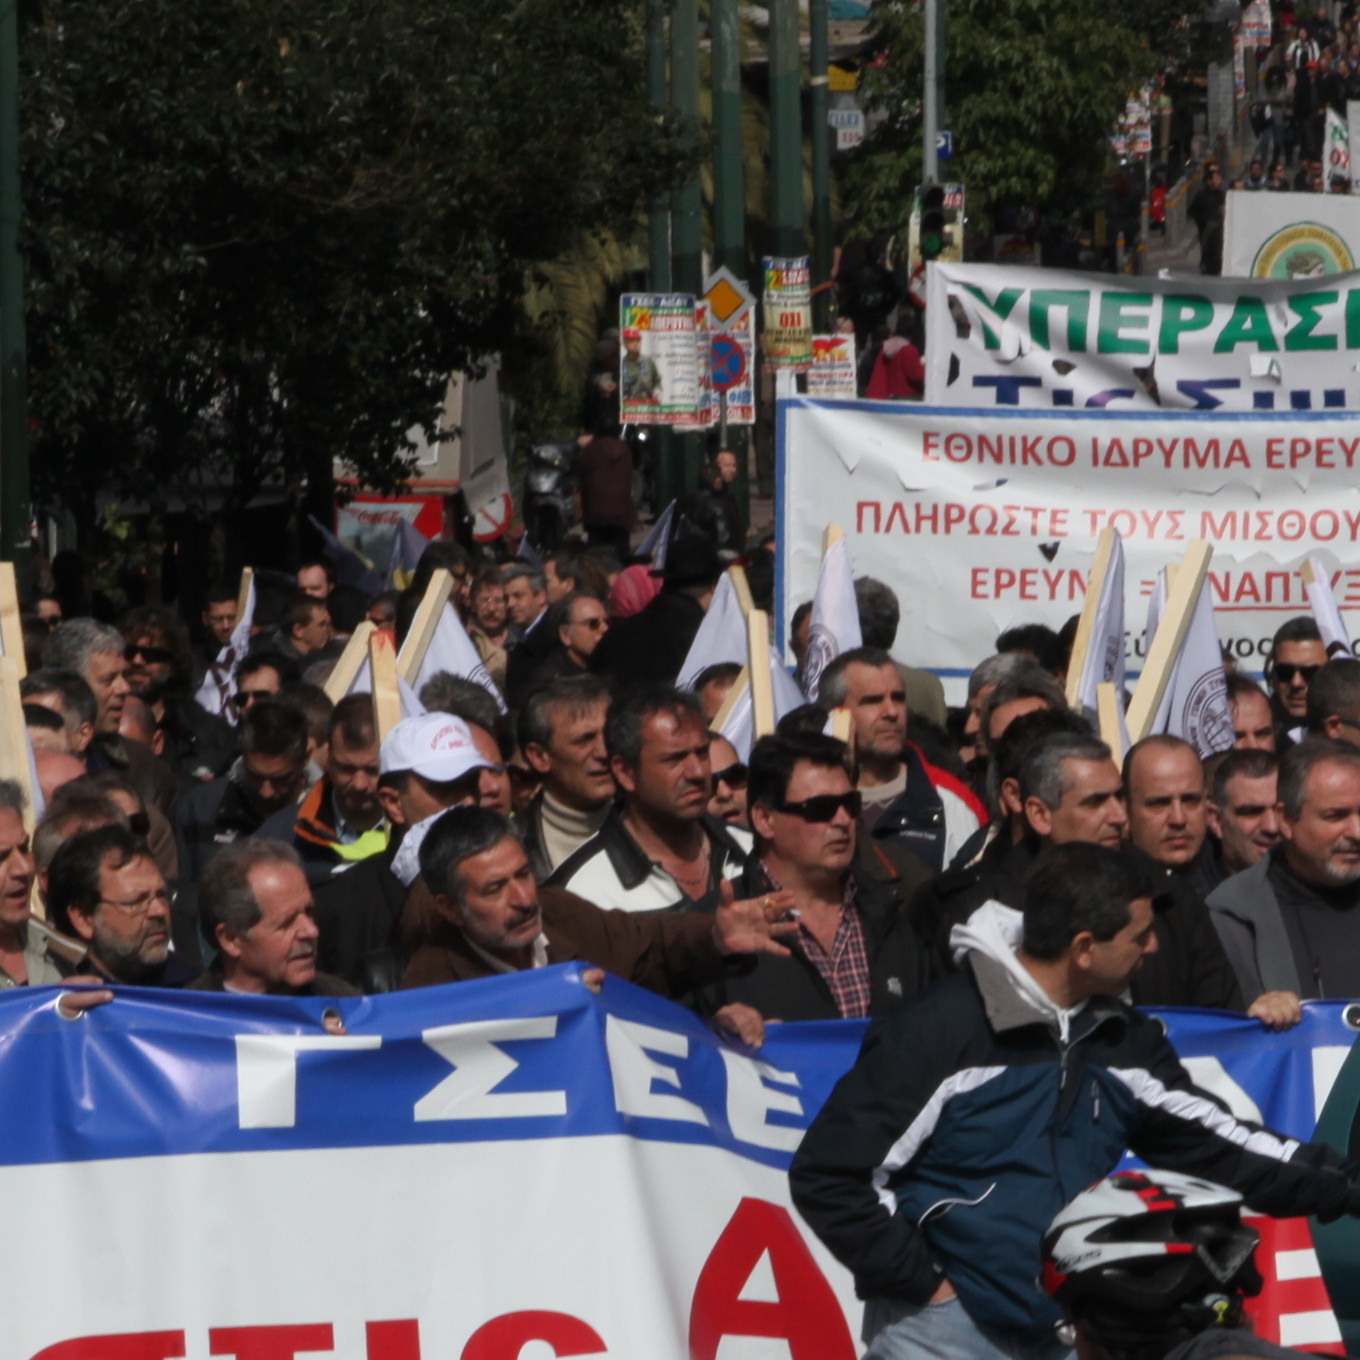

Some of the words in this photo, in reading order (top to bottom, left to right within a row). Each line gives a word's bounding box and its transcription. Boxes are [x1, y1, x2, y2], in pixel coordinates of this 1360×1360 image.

[922, 430, 1076, 467] ΕΘΝΙΚΟ
[1091, 436, 1251, 469] ΙΔΡΥΜΑ
[856, 501, 1070, 538] ΠΛΗΡΩΣΤΕ
[1083, 508, 1186, 540] ΤΟΥΣ
[235, 1014, 812, 1156] ΓΣΕΕ
